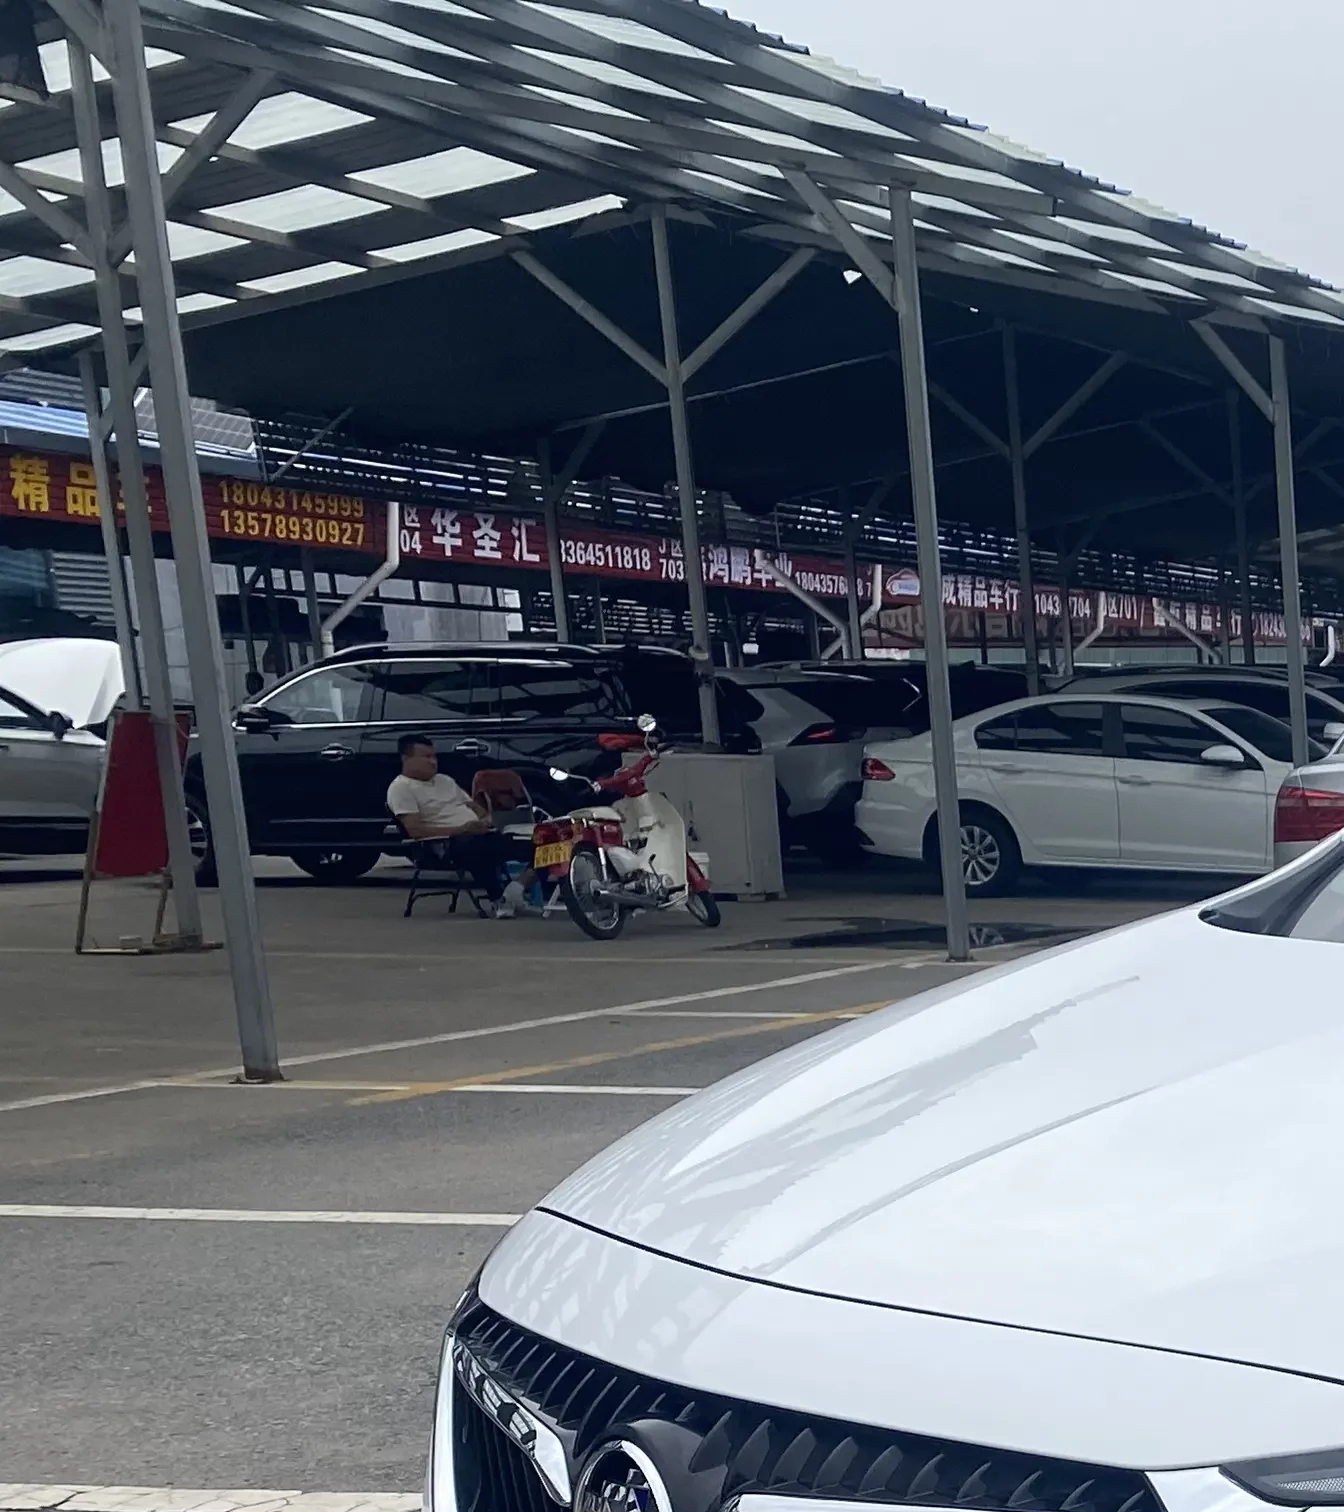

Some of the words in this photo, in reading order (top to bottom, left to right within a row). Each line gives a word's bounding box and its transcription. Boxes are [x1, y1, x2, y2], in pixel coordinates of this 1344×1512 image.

[219, 480, 365, 518] 18043145999
[220, 510, 365, 546] 13578930927
[431, 507, 541, 563] 华圣汇
[701, 544, 793, 588] 鸿鹏车业
